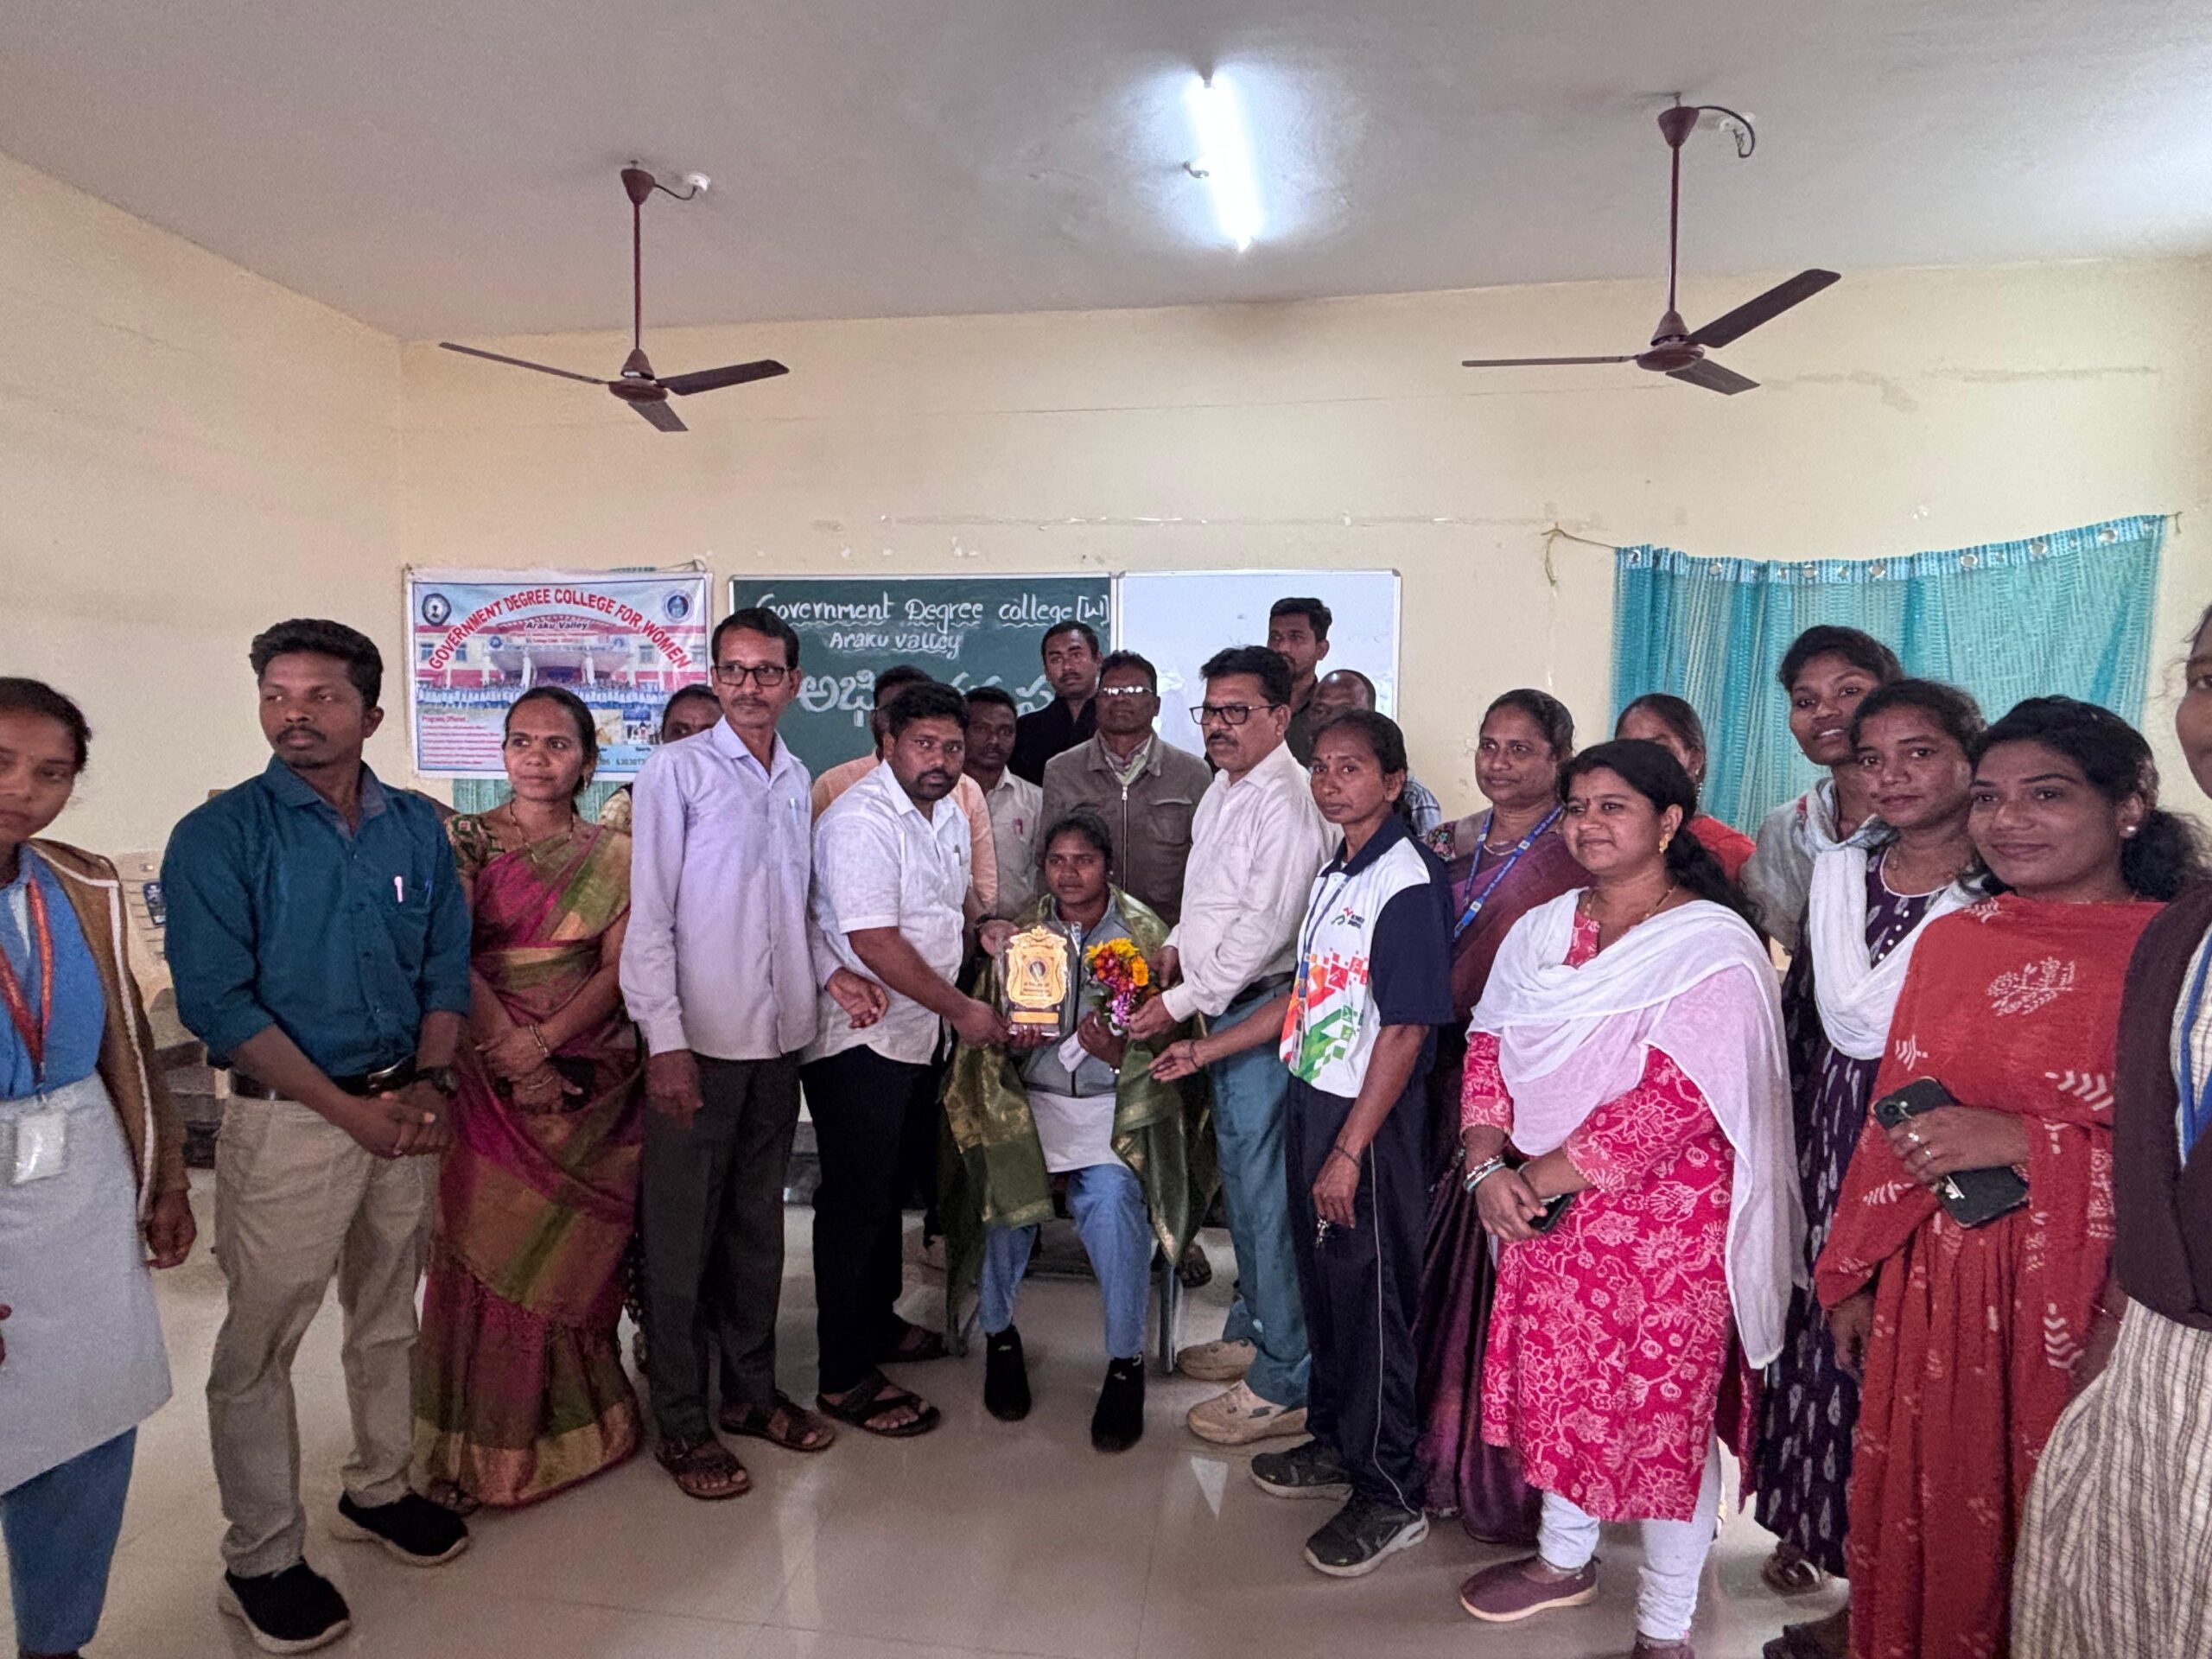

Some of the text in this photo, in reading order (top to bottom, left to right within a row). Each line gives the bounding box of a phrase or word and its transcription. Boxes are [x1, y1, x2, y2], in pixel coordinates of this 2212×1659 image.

[429, 588, 692, 670] GOVERNMENT DEGREE COLLEGE FOR WOMEN
[558, 622, 588, 631] Valley
[905, 598, 983, 634] Degree
[829, 632, 889, 650] Araku
